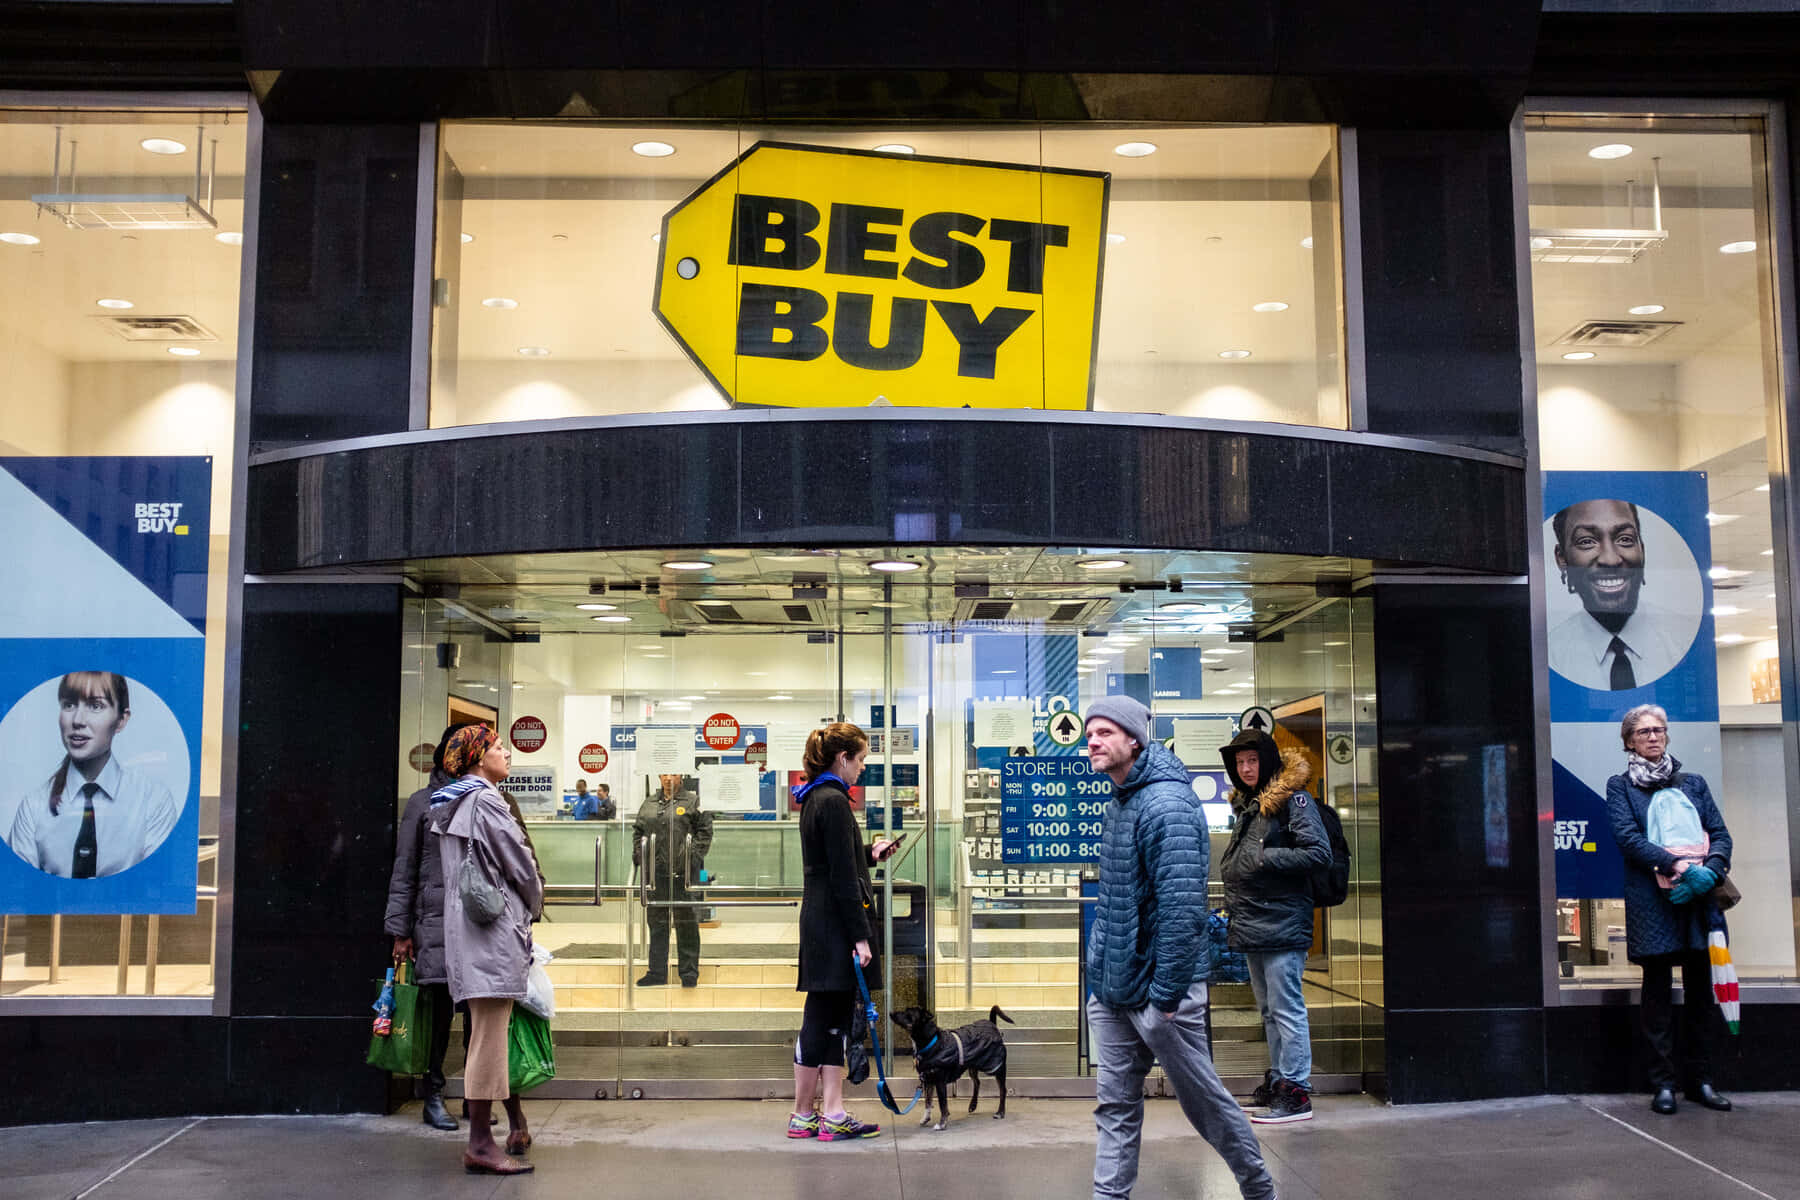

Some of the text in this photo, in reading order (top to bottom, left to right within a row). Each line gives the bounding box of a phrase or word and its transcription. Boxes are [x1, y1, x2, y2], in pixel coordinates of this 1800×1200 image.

[728, 193, 1069, 295] BEST
[735, 282, 1036, 380] BUY
[135, 503, 183, 518] BEST
[137, 518, 178, 533] BUY
[515, 721, 541, 730] DO NOT
[708, 719, 735, 727] DO NOT
[516, 740, 540, 748] ENTER
[709, 737, 734, 745] ENTER
[583, 762, 603, 770] ENTER
[1005, 761, 1097, 776] STORE HOU
[535, 776, 553, 784] USE
[498, 784, 552, 792] OTHER DOOR
[1031, 782, 1066, 796] 9:00
[1032, 803, 1067, 817] 9:00
[1027, 822, 1070, 836] 10:00
[1078, 822, 1102, 836] 9:0
[1554, 820, 1589, 835] EST
[1027, 843, 1070, 857] 11:00
[1078, 842, 1101, 857] 8:0
